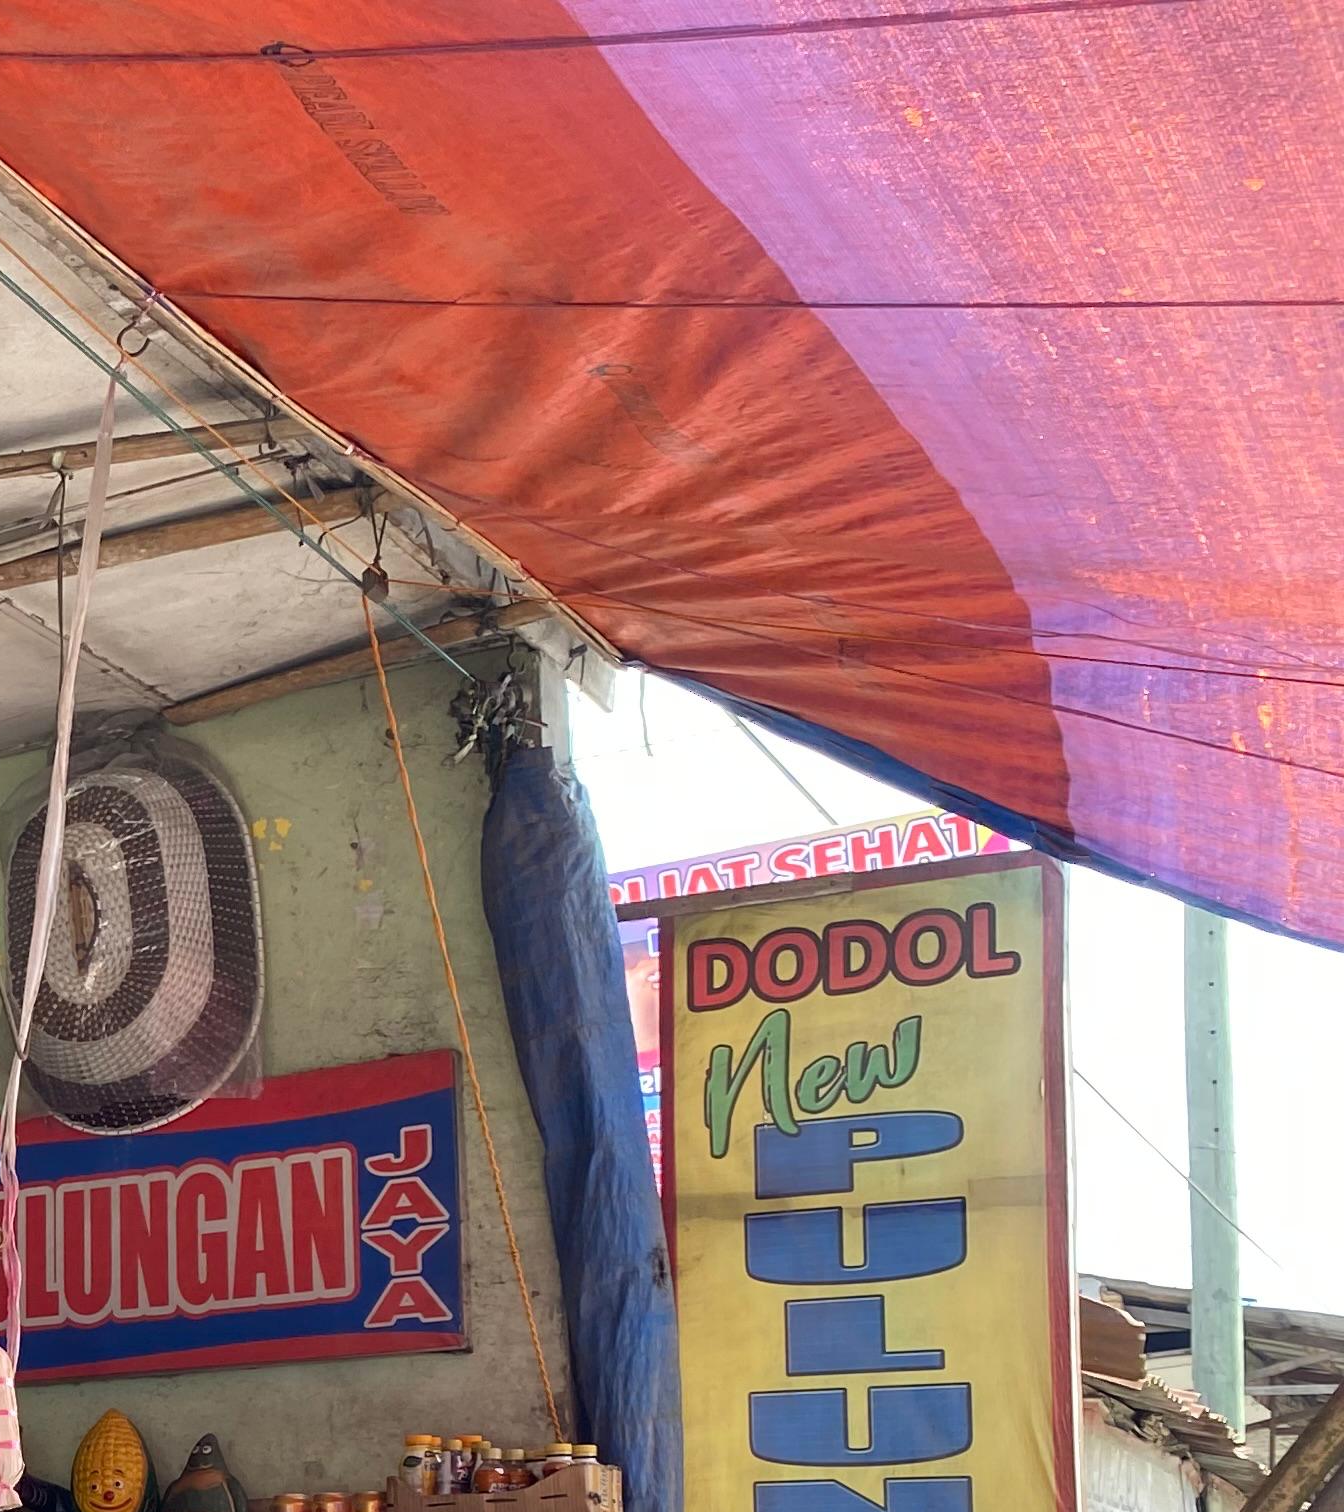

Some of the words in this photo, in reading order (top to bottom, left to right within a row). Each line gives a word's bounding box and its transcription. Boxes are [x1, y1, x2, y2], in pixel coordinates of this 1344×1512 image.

[769, 811, 978, 882] SEHAT
[688, 902, 1021, 1011] DODOL
[704, 1009, 921, 1158] New
[362, 1124, 453, 1328] JAYA
